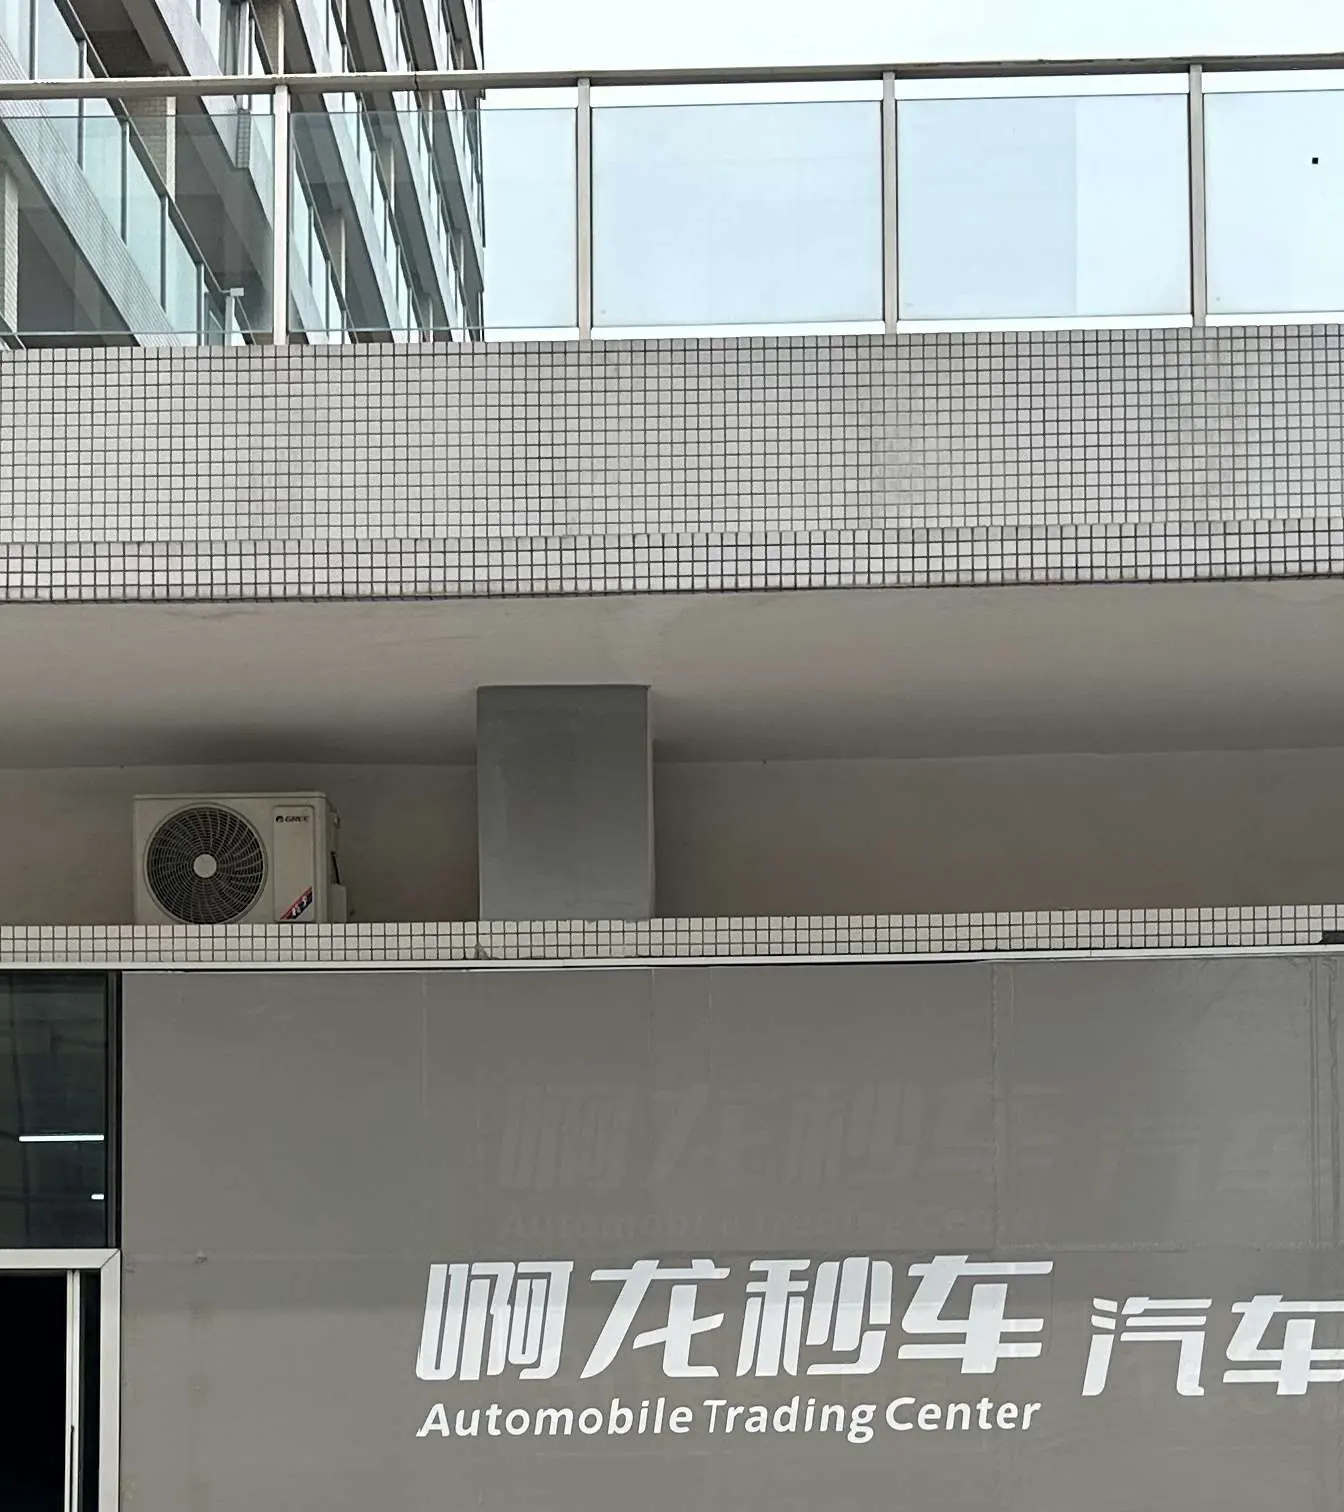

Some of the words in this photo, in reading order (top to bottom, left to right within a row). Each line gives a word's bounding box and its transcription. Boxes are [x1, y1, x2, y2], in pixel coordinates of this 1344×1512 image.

[415, 1254, 1054, 1382] 啊龙秒车
[415, 1397, 693, 1438] Automobile
[703, 1396, 877, 1444] Trading
[885, 1396, 1042, 1431] Center
